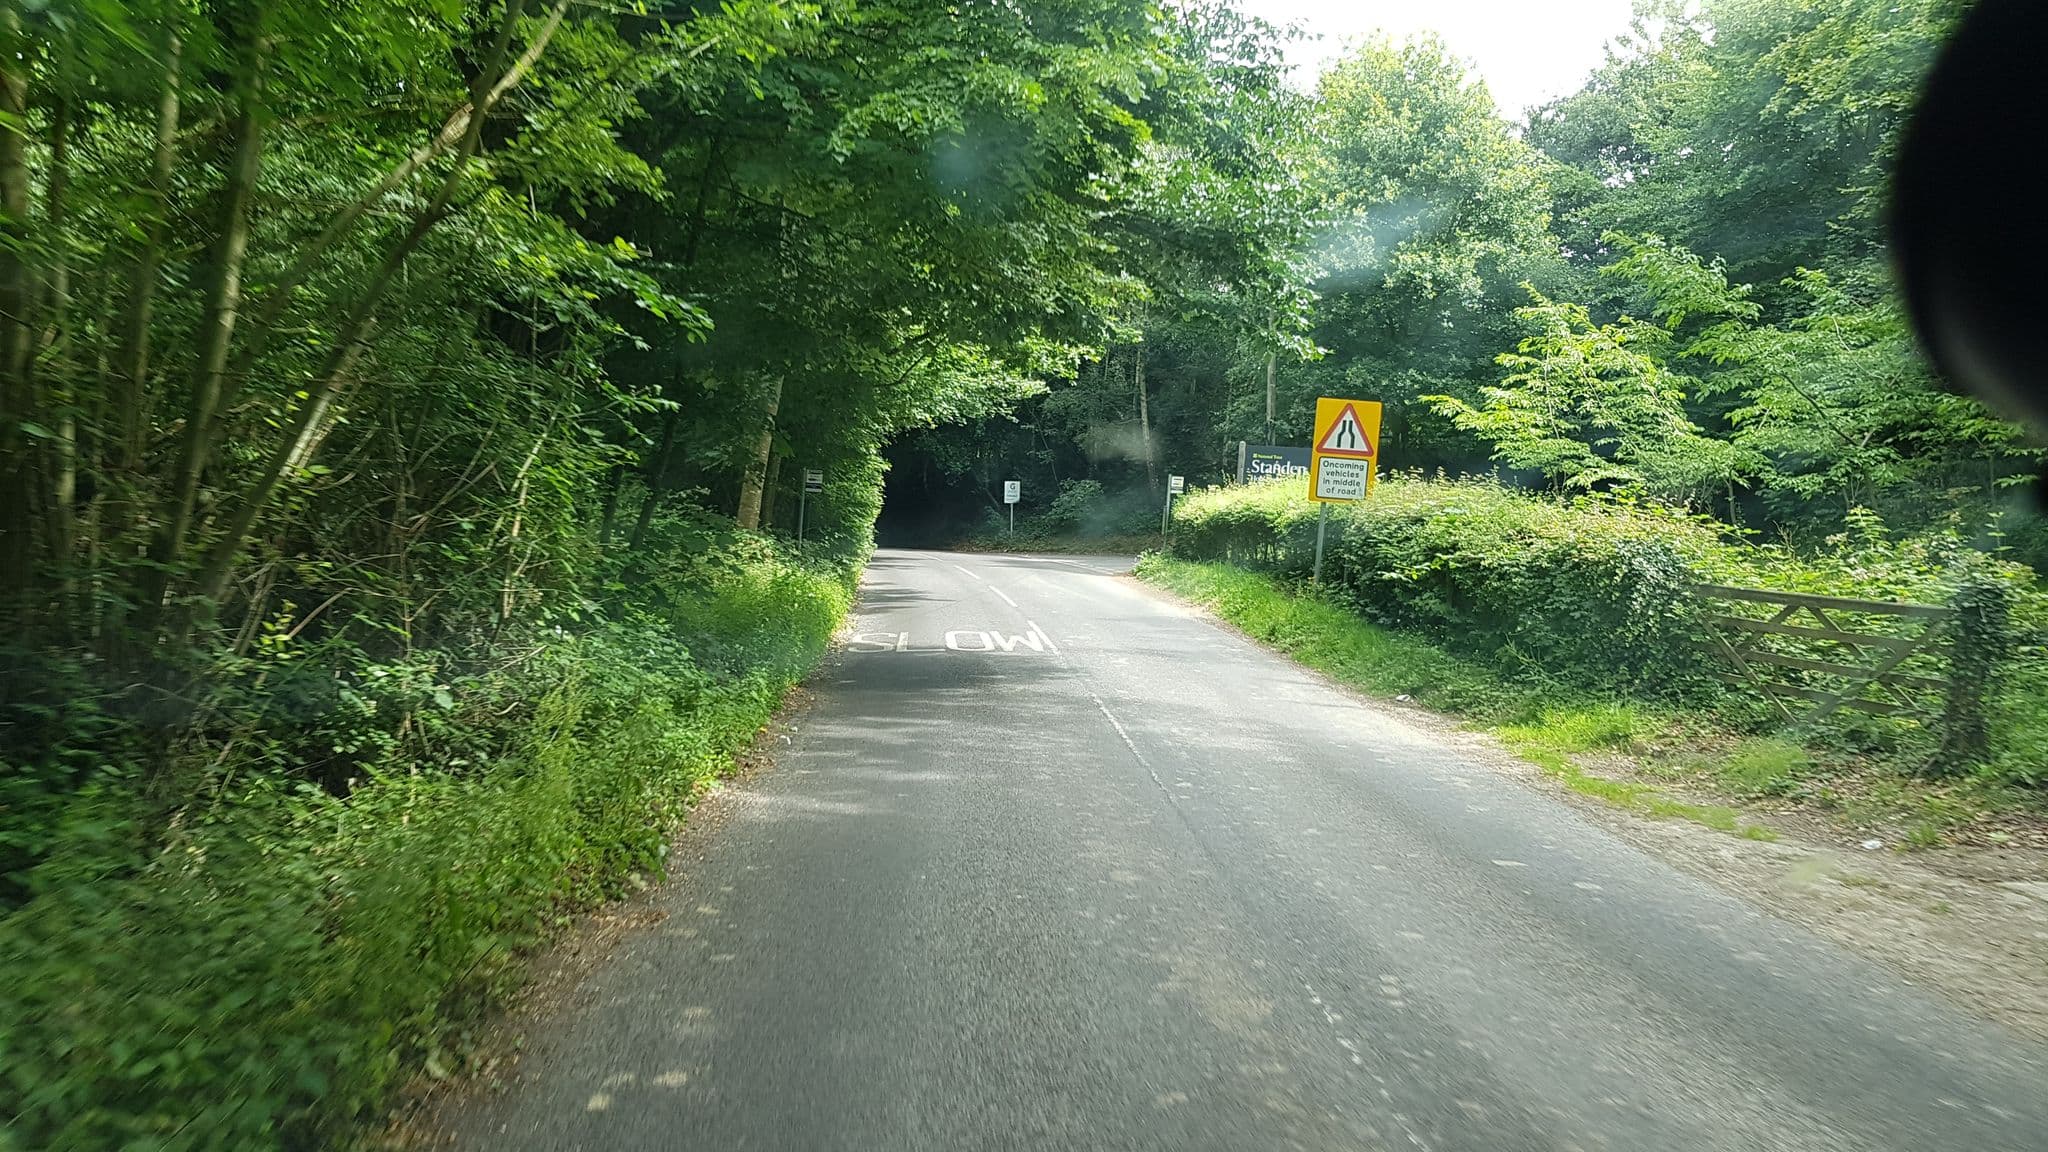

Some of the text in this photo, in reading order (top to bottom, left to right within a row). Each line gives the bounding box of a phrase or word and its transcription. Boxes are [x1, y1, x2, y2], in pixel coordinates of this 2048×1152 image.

[1251, 459, 1308, 475] Standen
[1323, 460, 1365, 471] Oncoming
[1326, 470, 1359, 478] vehicles
[1333, 479, 1361, 487] middle
[1326, 486, 1357, 495] of road
[847, 630, 1045, 652] SLOW
